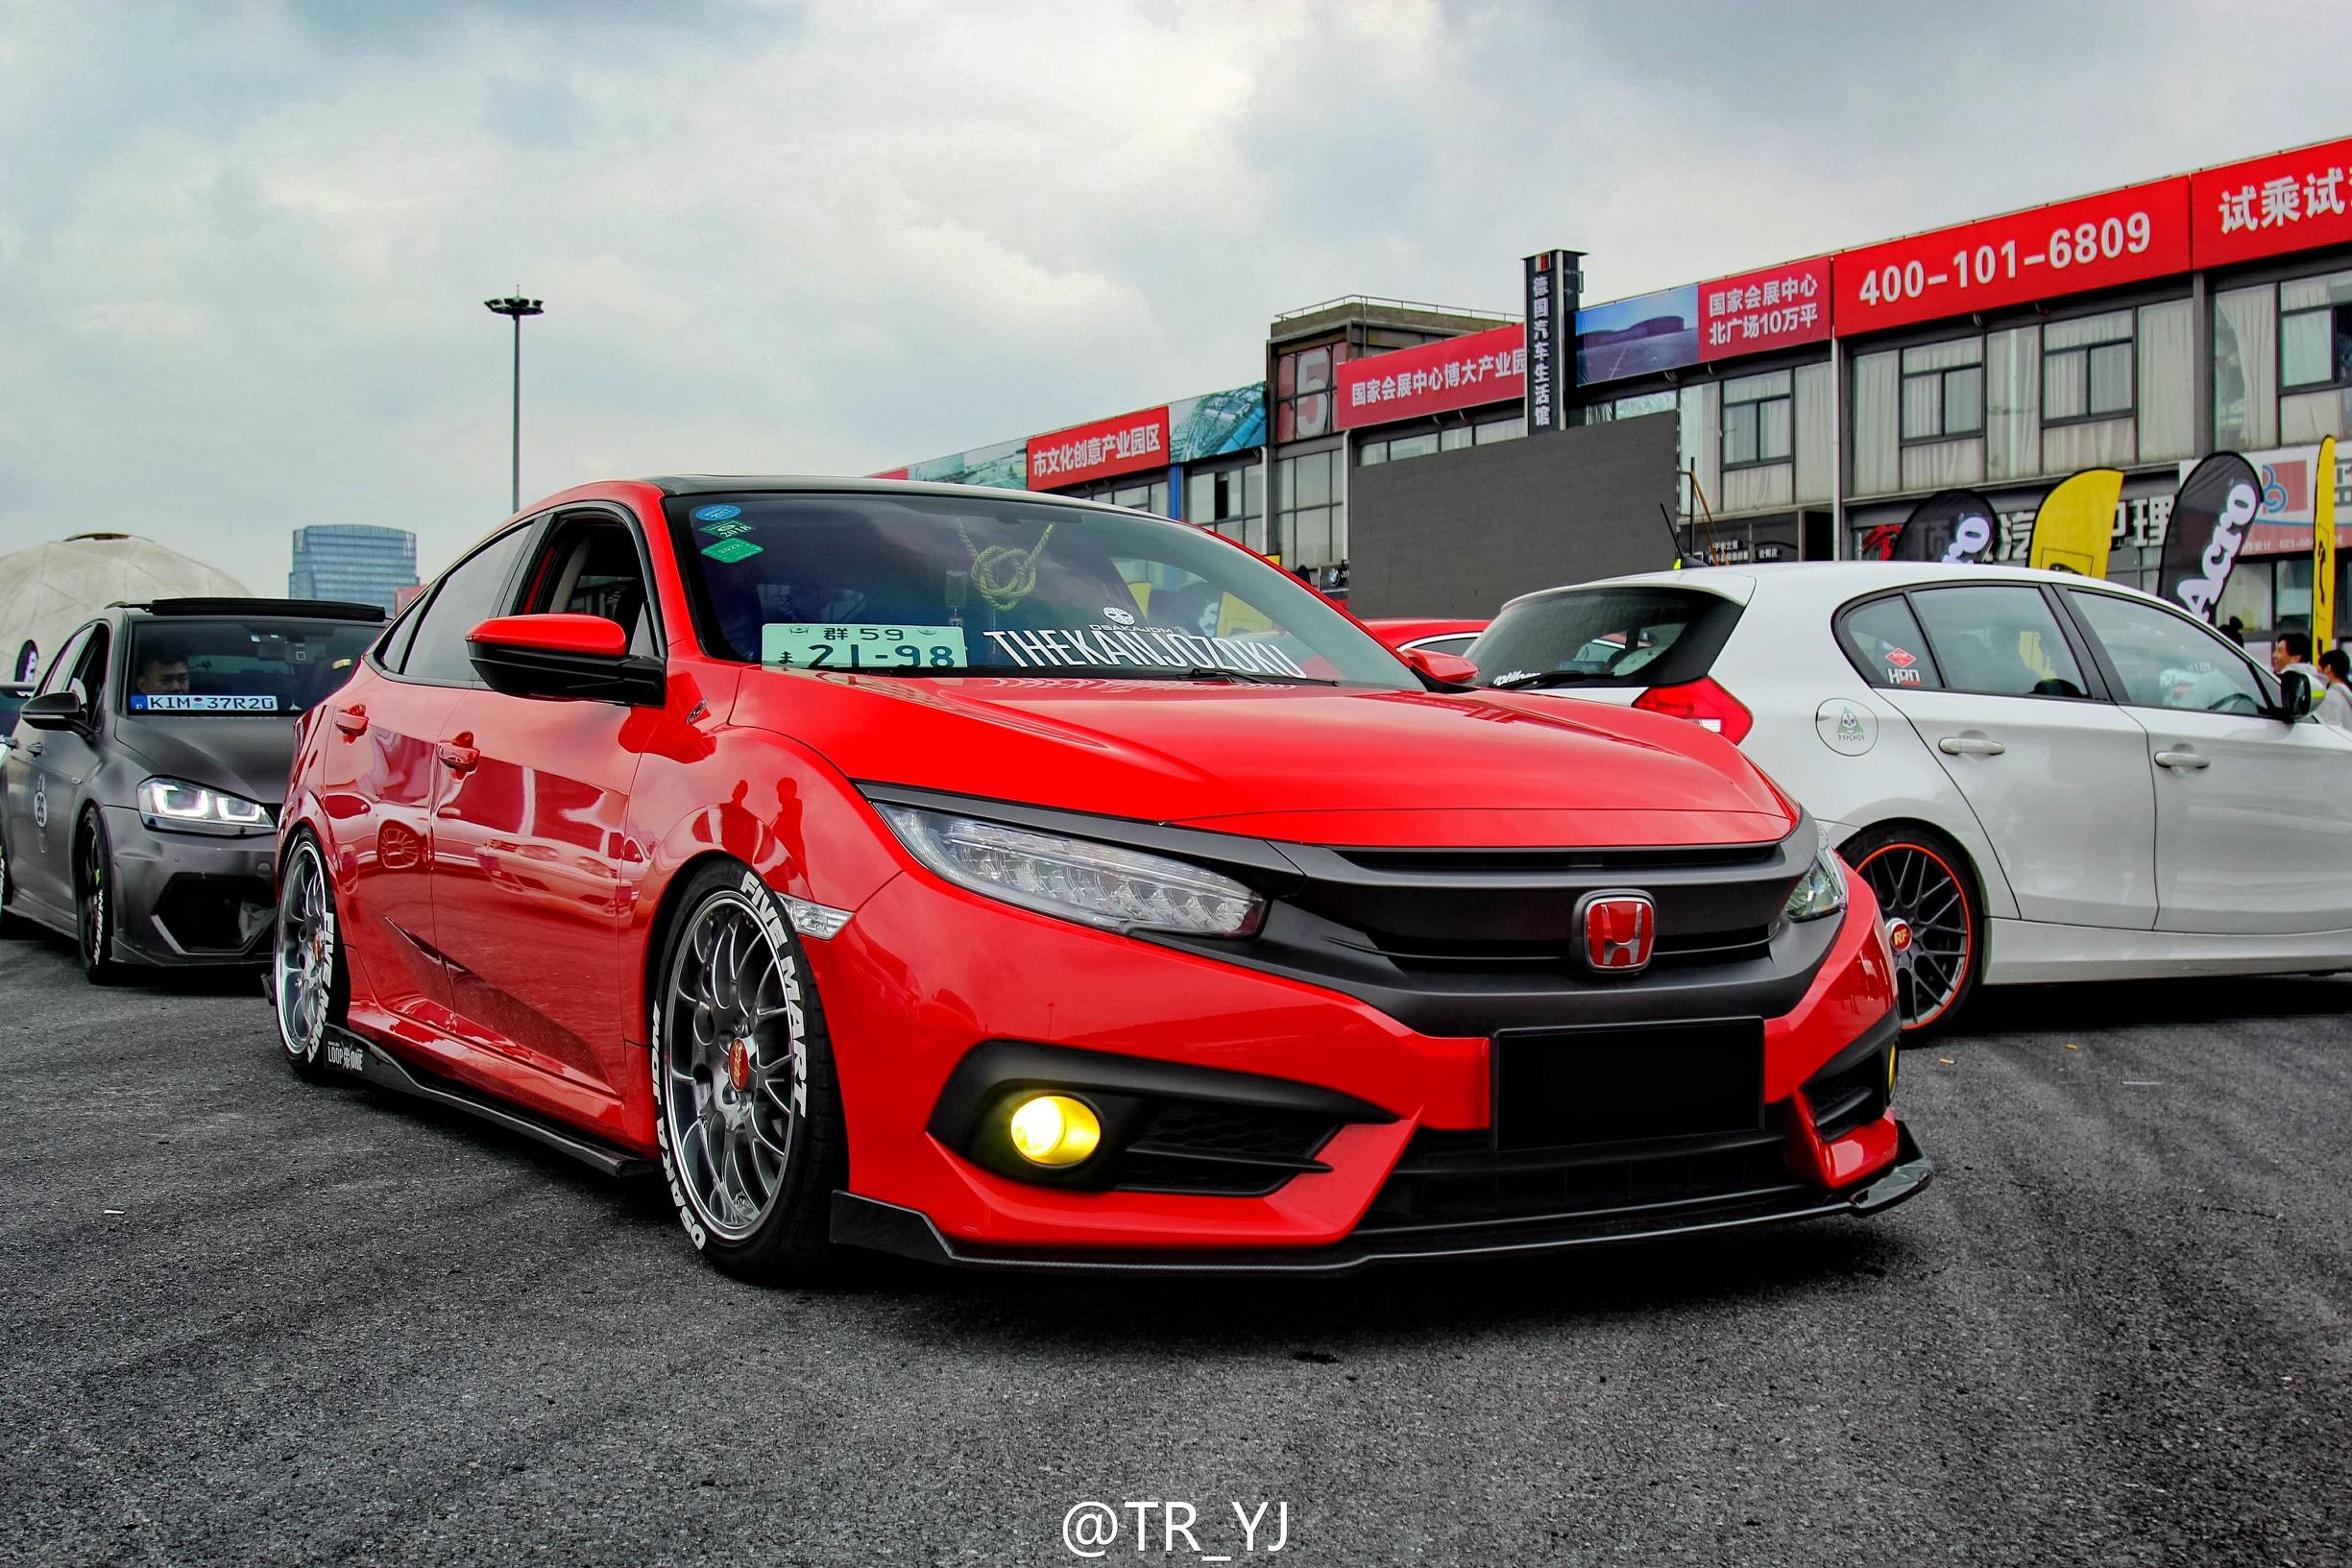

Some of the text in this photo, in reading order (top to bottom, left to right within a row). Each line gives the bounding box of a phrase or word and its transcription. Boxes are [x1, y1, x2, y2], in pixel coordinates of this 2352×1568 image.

[2219, 166, 2352, 234] 试乘试
[1859, 211, 2152, 306] 400-101-6809
[1709, 273, 1818, 318] 国家会展中心
[1532, 275, 1551, 426] 德国汽车生活馆
[1709, 302, 1818, 346] 北广场10万平
[1351, 348, 1527, 408] 国家会展中心博大产业园
[1032, 422, 1161, 478] 市文化创意产业园区
[808, 644, 955, 668] 21-98
[823, 627, 904, 640] 群 59
[150, 697, 190, 709] KIM
[740, 870, 808, 1119] FIVE MART
[327, 1045, 344, 1065] LOOP
[656, 1116, 707, 1250] OSAKA
